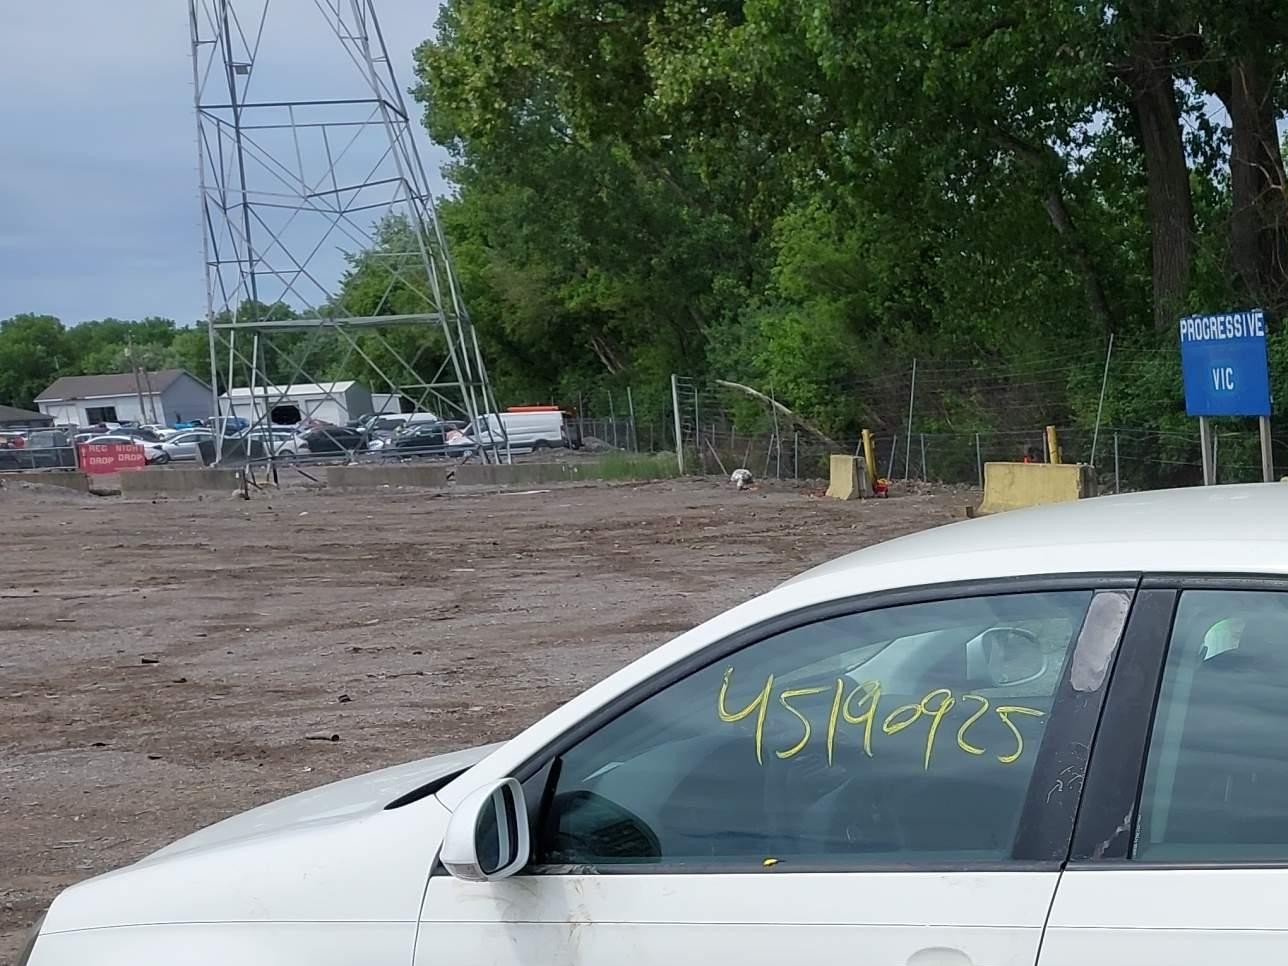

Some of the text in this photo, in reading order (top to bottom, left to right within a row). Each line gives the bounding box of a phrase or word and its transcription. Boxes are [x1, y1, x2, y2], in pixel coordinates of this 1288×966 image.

[1180, 312, 1264, 342] PROGRESSIVE
[1212, 367, 1234, 390] VIC
[90, 456, 114, 465] DROP
[118, 453, 143, 462] DROP
[718, 665, 1046, 772] 45190925
